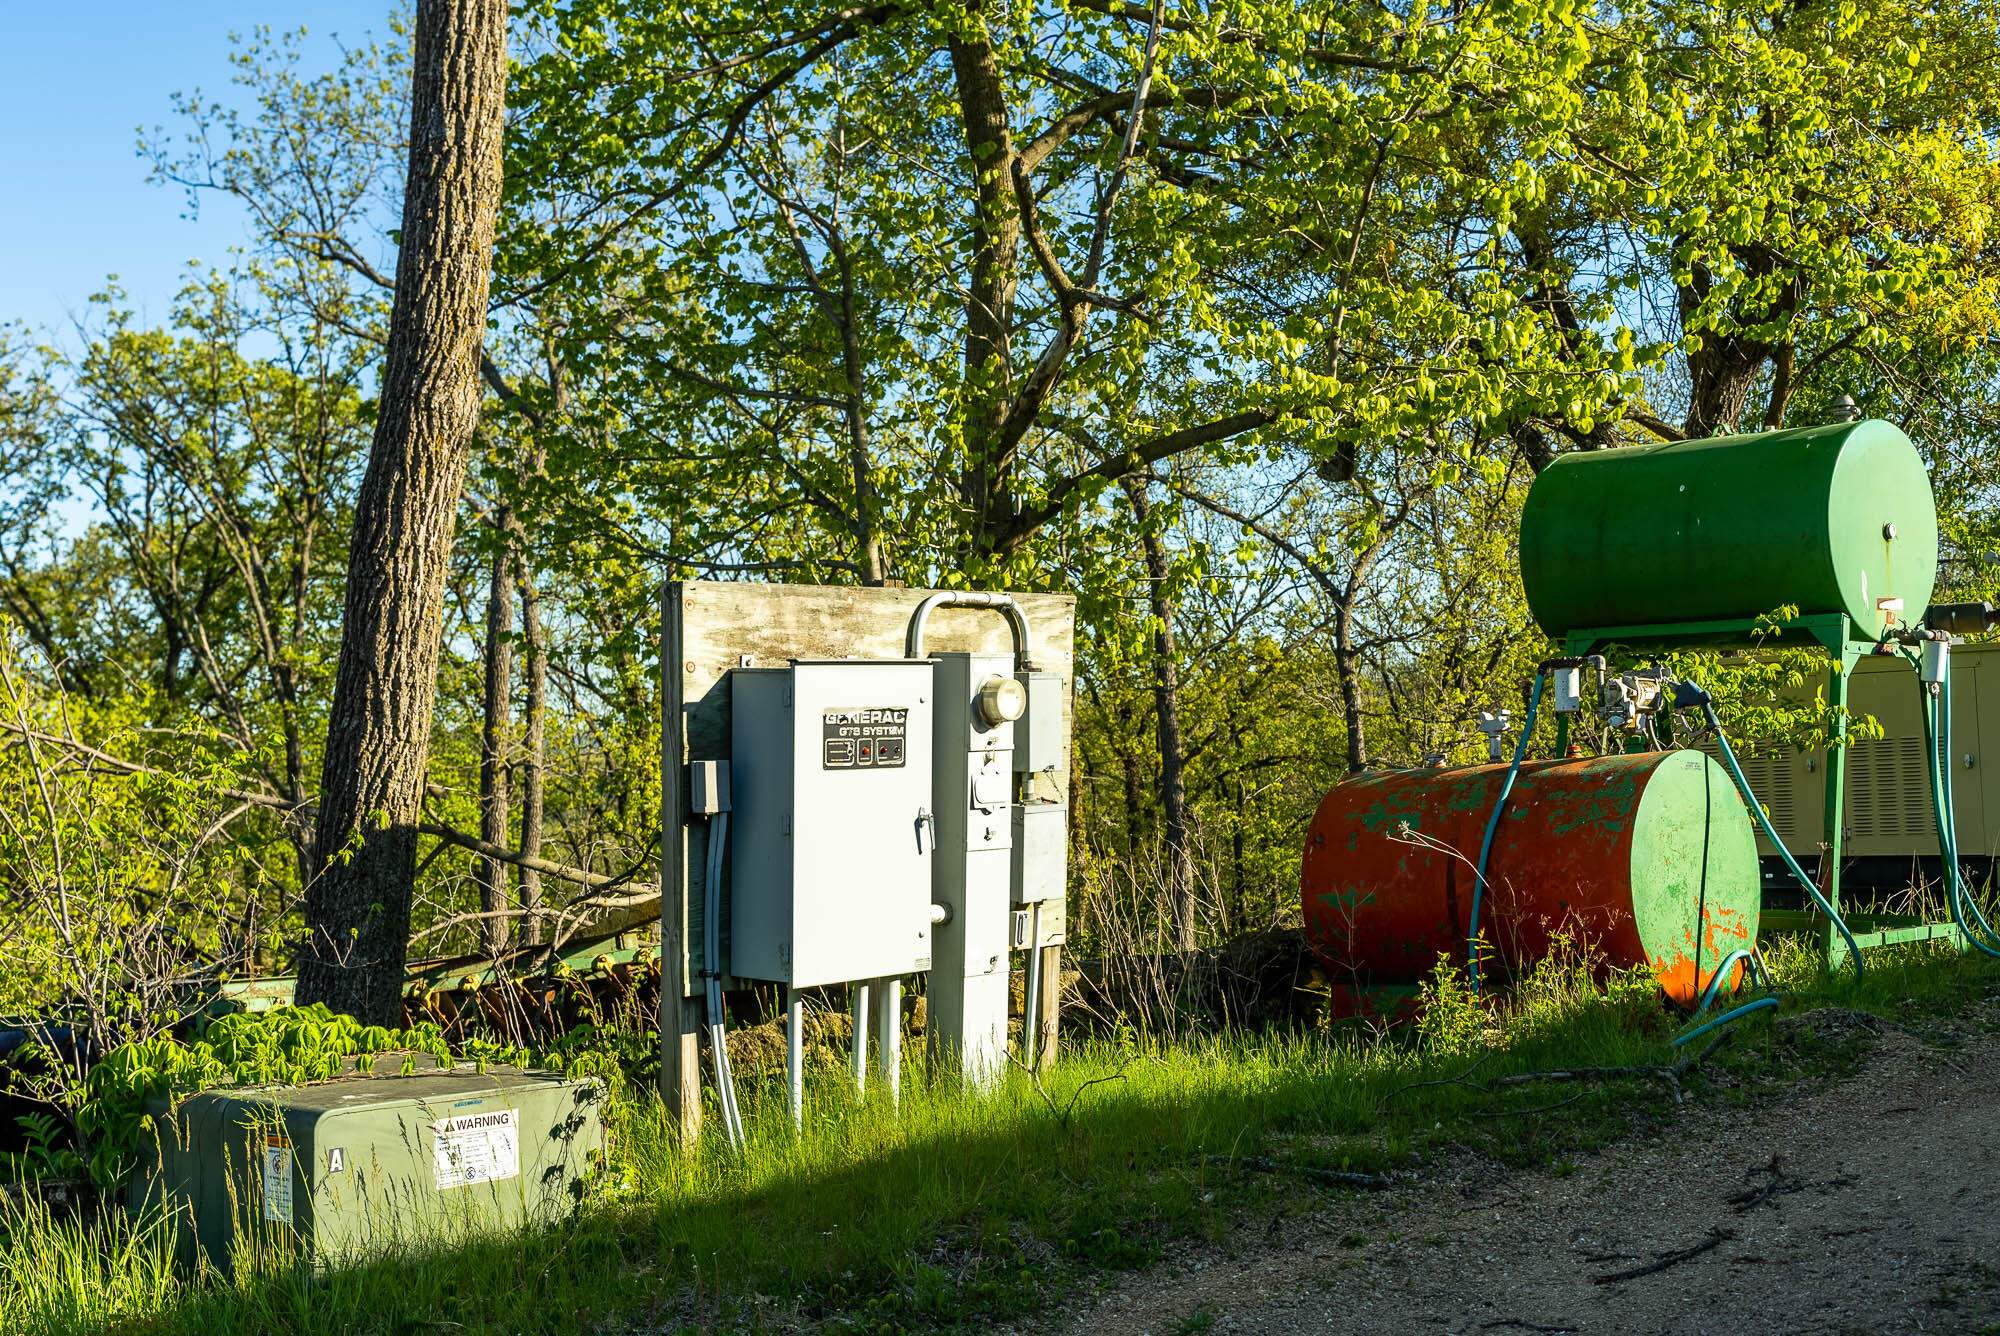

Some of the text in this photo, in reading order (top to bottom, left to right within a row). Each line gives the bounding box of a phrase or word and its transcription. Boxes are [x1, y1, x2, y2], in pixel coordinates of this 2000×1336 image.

[825, 710, 905, 724] GENERAC
[862, 726, 904, 736] SYSTEM
[456, 1113, 509, 1130] WARNING
[329, 1149, 344, 1172] A
